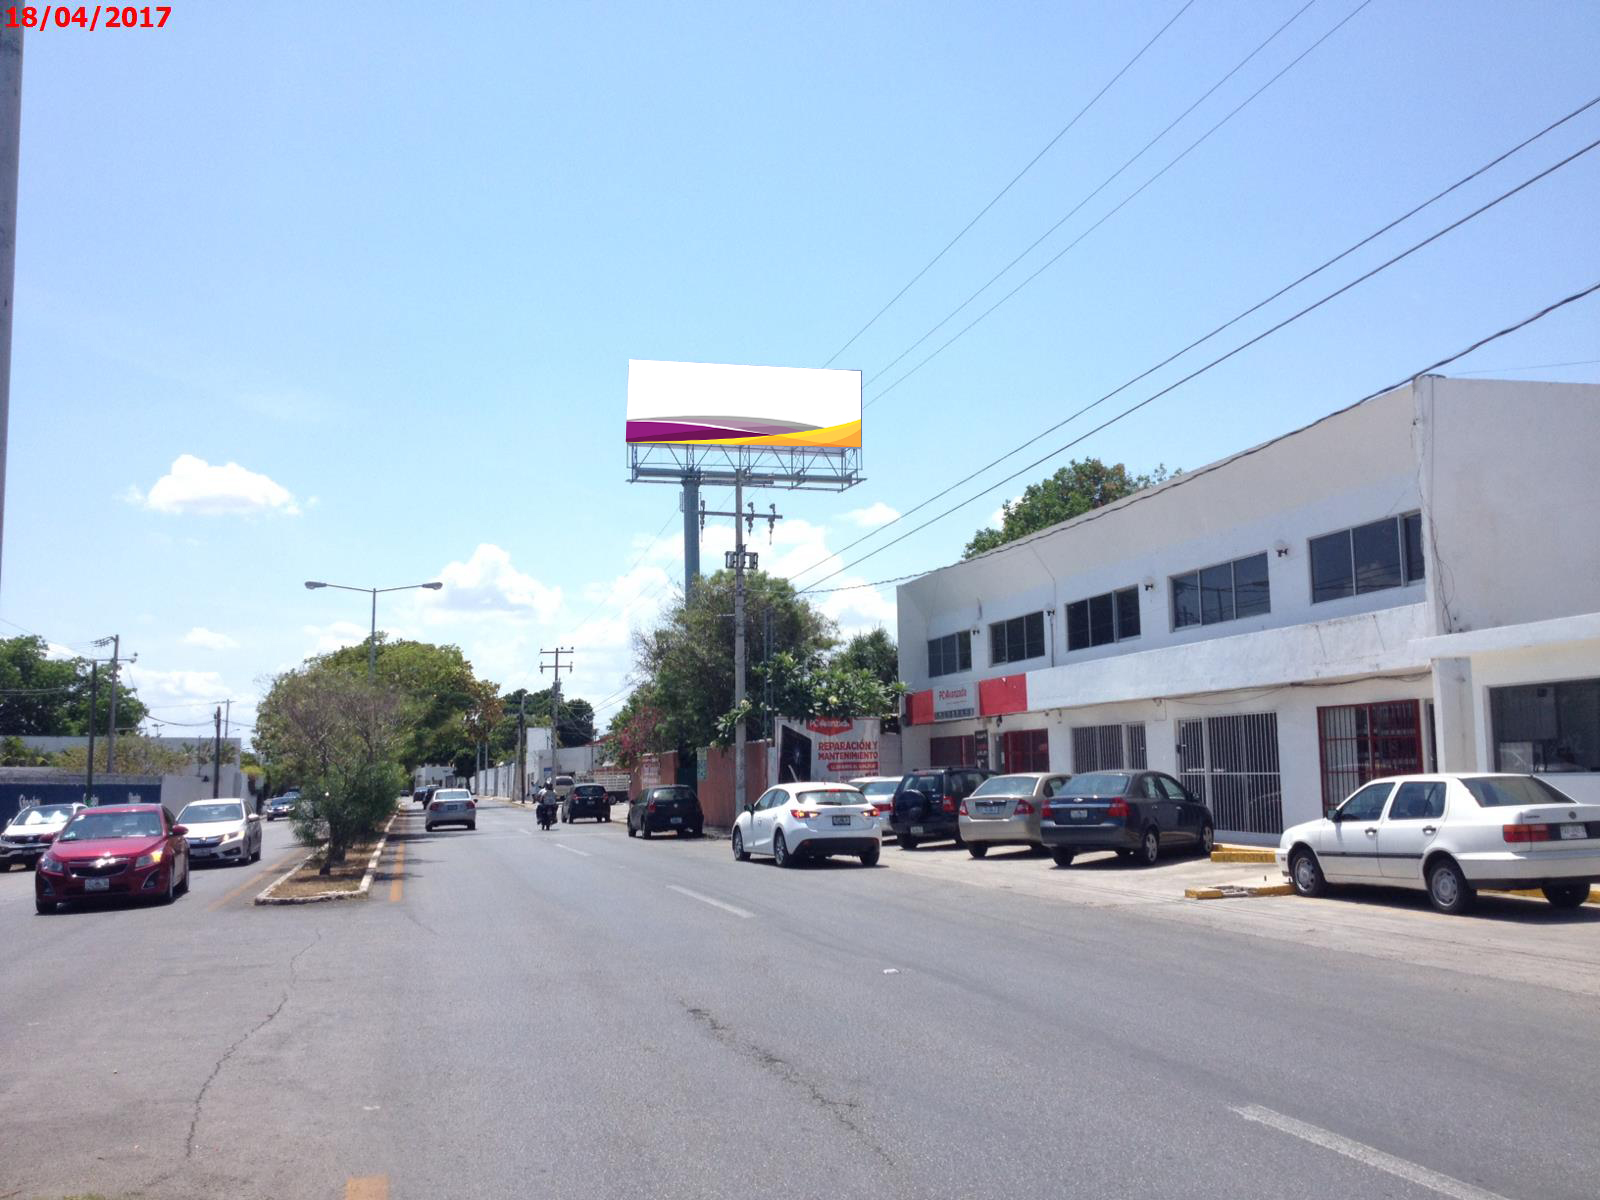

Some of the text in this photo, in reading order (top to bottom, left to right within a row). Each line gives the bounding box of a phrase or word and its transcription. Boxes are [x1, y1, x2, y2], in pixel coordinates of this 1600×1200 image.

[818, 739, 878, 751] REPARACIÓN Y
[818, 751, 878, 760] MANTENIMIENTO
